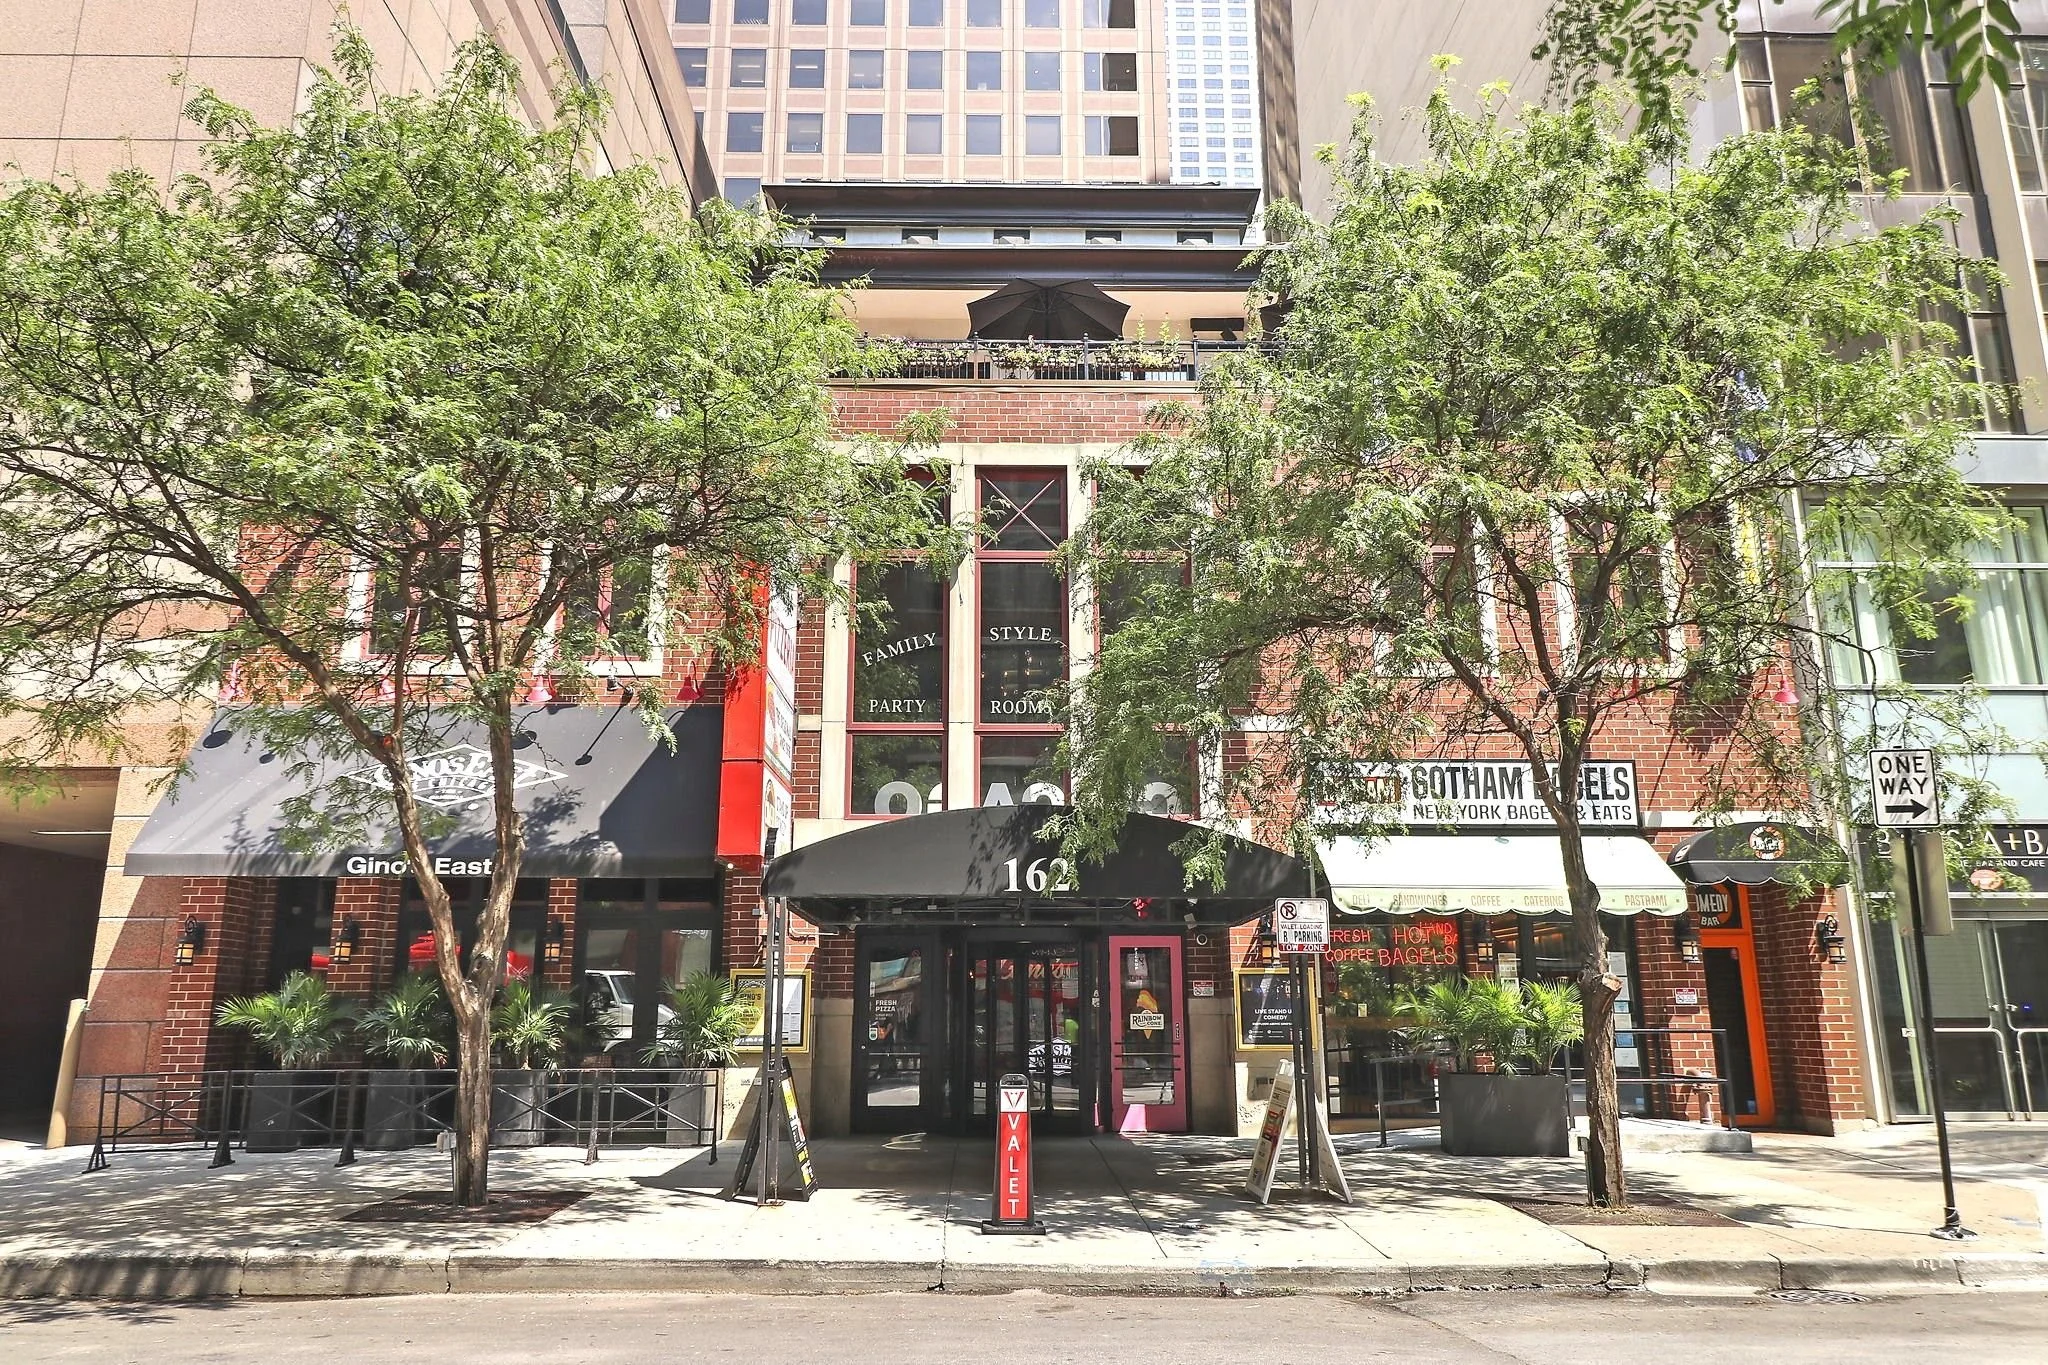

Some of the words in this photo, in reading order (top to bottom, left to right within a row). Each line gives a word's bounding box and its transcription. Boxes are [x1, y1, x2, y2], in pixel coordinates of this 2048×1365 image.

[862, 632, 937, 667] FAMILY
[989, 626, 1052, 642] STYLE
[868, 699, 926, 713] PARTY
[990, 699, 1051, 715] ROOMS
[1878, 756, 1927, 774] ONE
[1411, 765, 1524, 800] GOTHAM
[1533, 766, 1631, 801] ELS
[1879, 777, 1928, 795] WAY
[1459, 804, 1502, 820] YORK
[1508, 804, 1572, 821] BAGE
[1593, 805, 1632, 821] EATS
[346, 856, 414, 875] Gino'
[434, 857, 493, 875] East
[2020, 859, 2046, 868] CAFE
[1003, 857, 1071, 892] 162
[1392, 895, 1449, 907] SANDWICHES
[1470, 895, 1502, 907] COFFEE
[1523, 895, 1565, 907] CATERING
[1624, 894, 1668, 907] PASTRAMI
[1700, 916, 1720, 926] BAR
[1293, 930, 1323, 943] PARKING
[1329, 929, 1372, 943] FRESH
[1393, 925, 1432, 946] HOT
[1281, 944, 1298, 952] TOW
[1302, 944, 1325, 952] ZONE
[1325, 949, 1375, 963] COFFEE
[1378, 946, 1458, 968] BAGELS
[1132, 1015, 1162, 1027] RAINBOW
[1006, 1113, 1021, 1216] VALET
